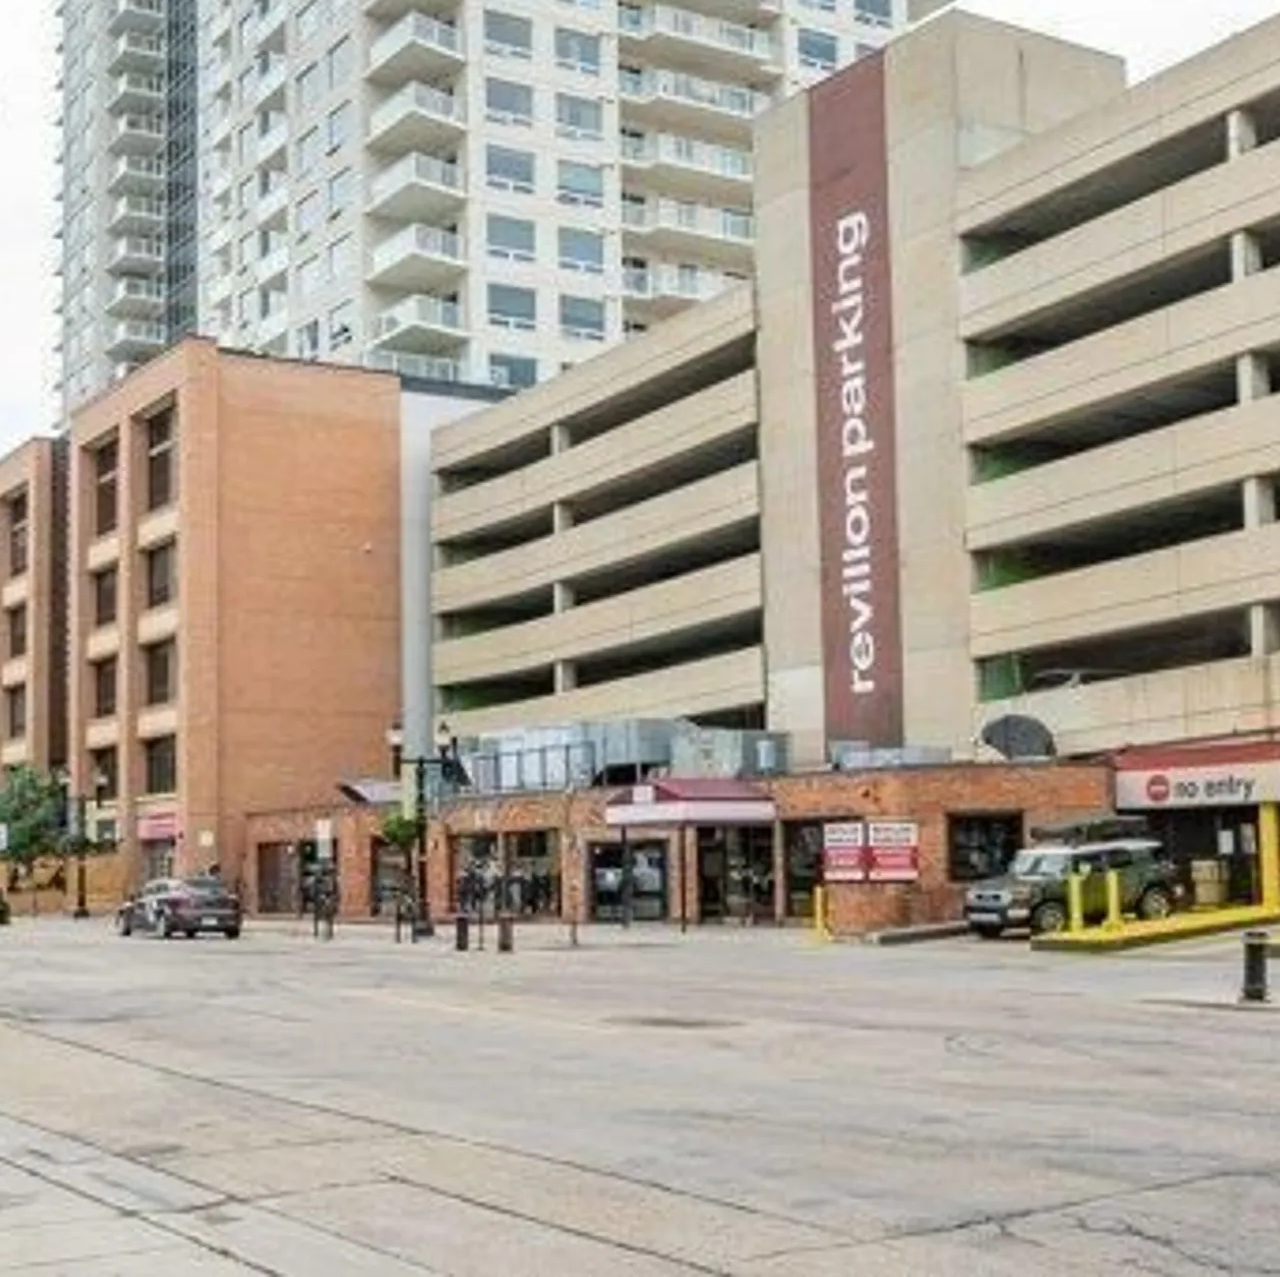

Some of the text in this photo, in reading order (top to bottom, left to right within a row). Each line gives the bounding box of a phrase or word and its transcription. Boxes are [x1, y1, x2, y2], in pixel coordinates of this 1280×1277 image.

[830, 210, 875, 694] revillon parking
[1173, 775, 1255, 802] no entry
